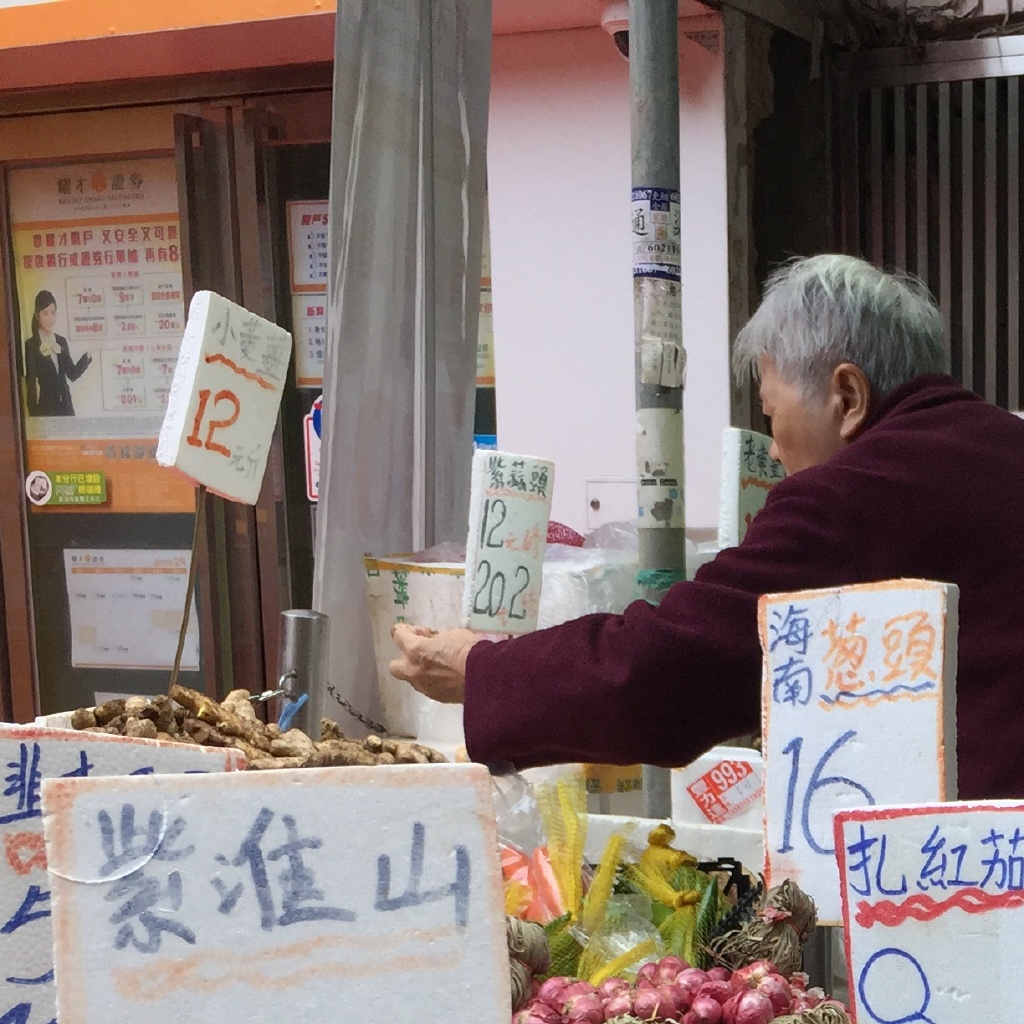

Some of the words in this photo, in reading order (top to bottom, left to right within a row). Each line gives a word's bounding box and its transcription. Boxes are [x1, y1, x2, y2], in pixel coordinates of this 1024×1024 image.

[186, 388, 241, 458] 12
[481, 498, 507, 549] 12
[769, 605, 814, 705] 海南
[780, 731, 876, 855] 16
[97, 803, 471, 953] 紫淮山
